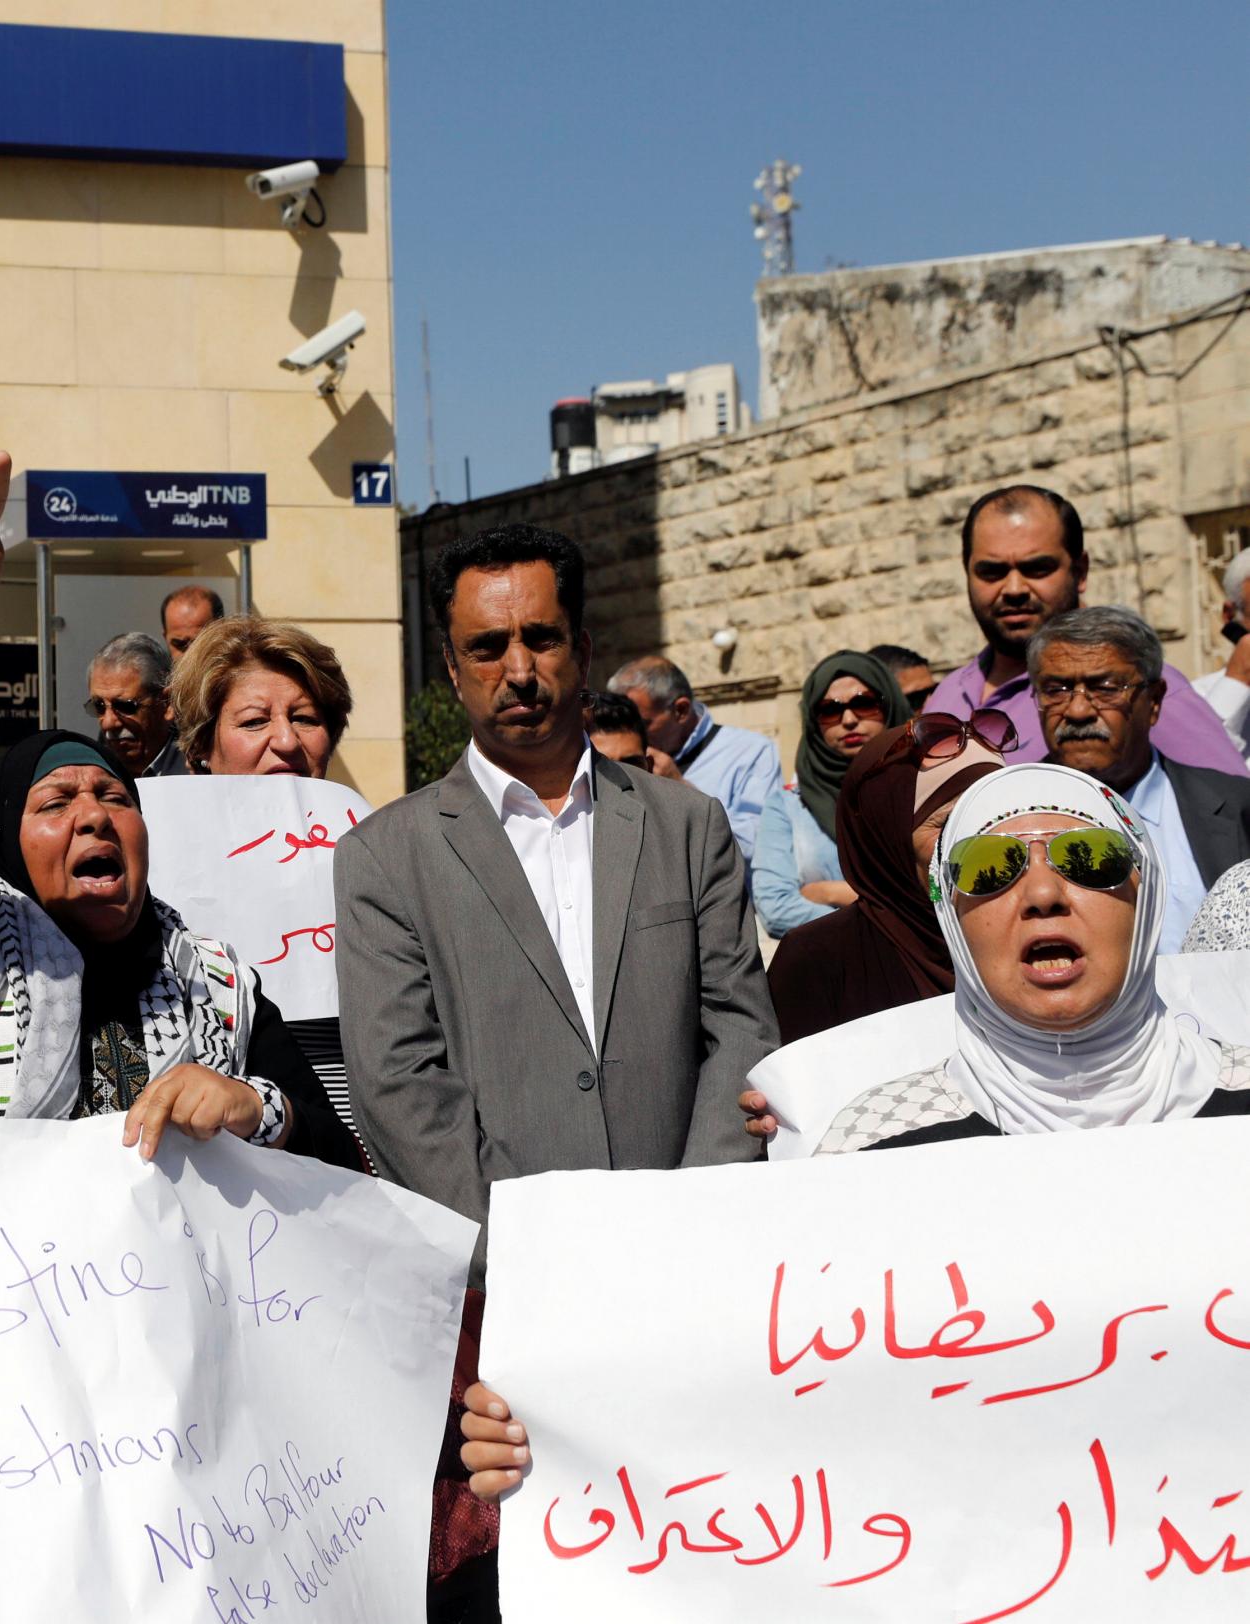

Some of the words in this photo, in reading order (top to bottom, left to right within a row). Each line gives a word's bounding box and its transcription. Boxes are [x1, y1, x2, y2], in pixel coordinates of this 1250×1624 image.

[49, 496, 71, 512] 24
[208, 486, 251, 504] TNB
[356, 471, 389, 498] 17
[237, 1208, 324, 1327] for
[769, 1261, 1169, 1405] بريطانيا
[212, 1495, 255, 1544] to
[244, 1440, 345, 1532] Balfour
[543, 1465, 912, 1587] والاعتراف
